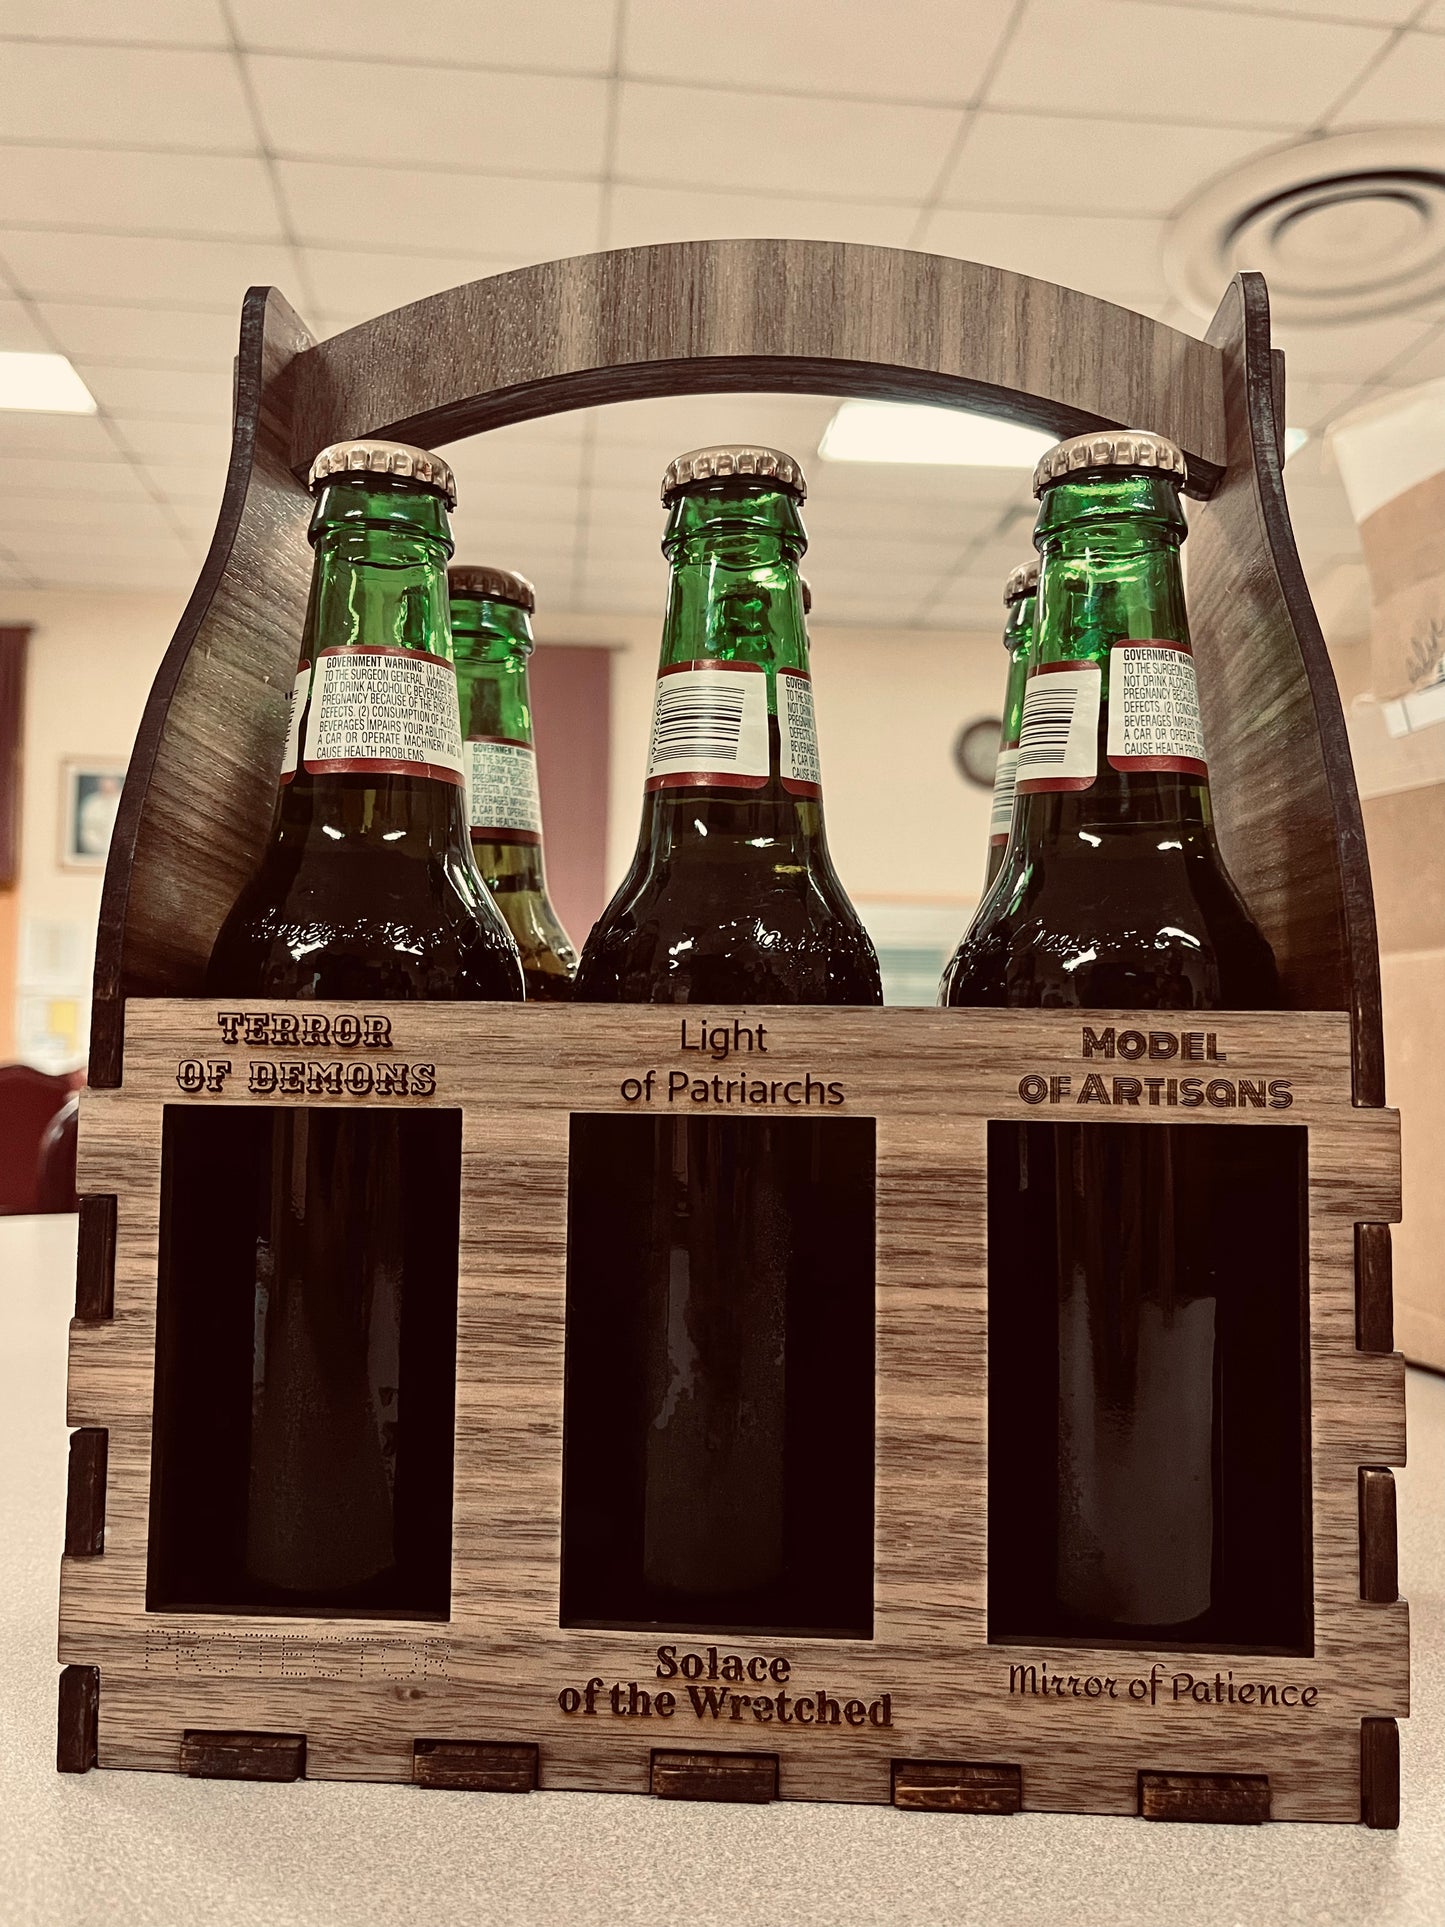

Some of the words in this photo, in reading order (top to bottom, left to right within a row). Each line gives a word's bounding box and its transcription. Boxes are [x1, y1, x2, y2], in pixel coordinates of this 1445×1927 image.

[1124, 649, 1176, 662] GOVERNMENT
[327, 656, 382, 669] GOVERNMENT
[384, 657, 424, 673] WARNING:
[1123, 663, 1133, 674] TO
[1137, 662, 1151, 674] THE
[1153, 663, 1183, 677] SURGEON
[325, 671, 333, 681] TO
[336, 670, 348, 680] THE
[351, 669, 388, 680] SURGEON
[1124, 676, 1140, 687] NOT
[1143, 675, 1167, 687] DRINK
[324, 682, 337, 693] NOT
[340, 682, 364, 692] DRINK
[367, 681, 411, 695] ALCOHOLIC
[1124, 688, 1170, 700] PREGNANCY
[322, 693, 368, 705] PREGNANCY
[371, 693, 406, 706] BECAUSE
[409, 697, 418, 708] OF
[420, 698, 432, 711] THE
[1124, 701, 1161, 713] DEFECTS.
[359, 705, 369, 719] (2)
[372, 706, 429, 723] CONSUMPTION
[431, 713, 439, 724] OF
[1125, 715, 1172, 727] BEVERAGES
[320, 719, 364, 732] BEVERAGES
[367, 719, 400, 732] IMPAIRS
[403, 722, 423, 734] YOUR
[1124, 729, 1130, 740] A
[1134, 728, 1151, 740] CAR
[1155, 728, 1167, 739] OR
[326, 732, 342, 744] CAR
[346, 732, 357, 743] OR
[362, 732, 400, 745] OPERATE
[317, 746, 342, 759] CAUSE
[345, 746, 376, 757] HEALTH
[1125, 743, 1153, 754] CAUSE
[1156, 743, 1184, 754] HEALTH
[218, 1012, 393, 1047] TERROR
[681, 1019, 768, 1060] Light
[1082, 1027, 1226, 1060] MODEL
[177, 1060, 231, 1093] OF
[248, 1061, 436, 1096] DEMONS
[620, 1069, 656, 1102] of
[668, 1071, 845, 1105] Patriarchs
[1018, 1074, 1071, 1104] OF
[145, 1629, 452, 1682] PROTECTOR
[656, 1646, 791, 1682] Solace
[1009, 1663, 1118, 1698] Mirror
[1128, 1664, 1165, 1705] of
[1170, 1671, 1319, 1707] Patience
[558, 1677, 604, 1714] of
[609, 1682, 676, 1716] the
[686, 1686, 894, 1727] Wretched
